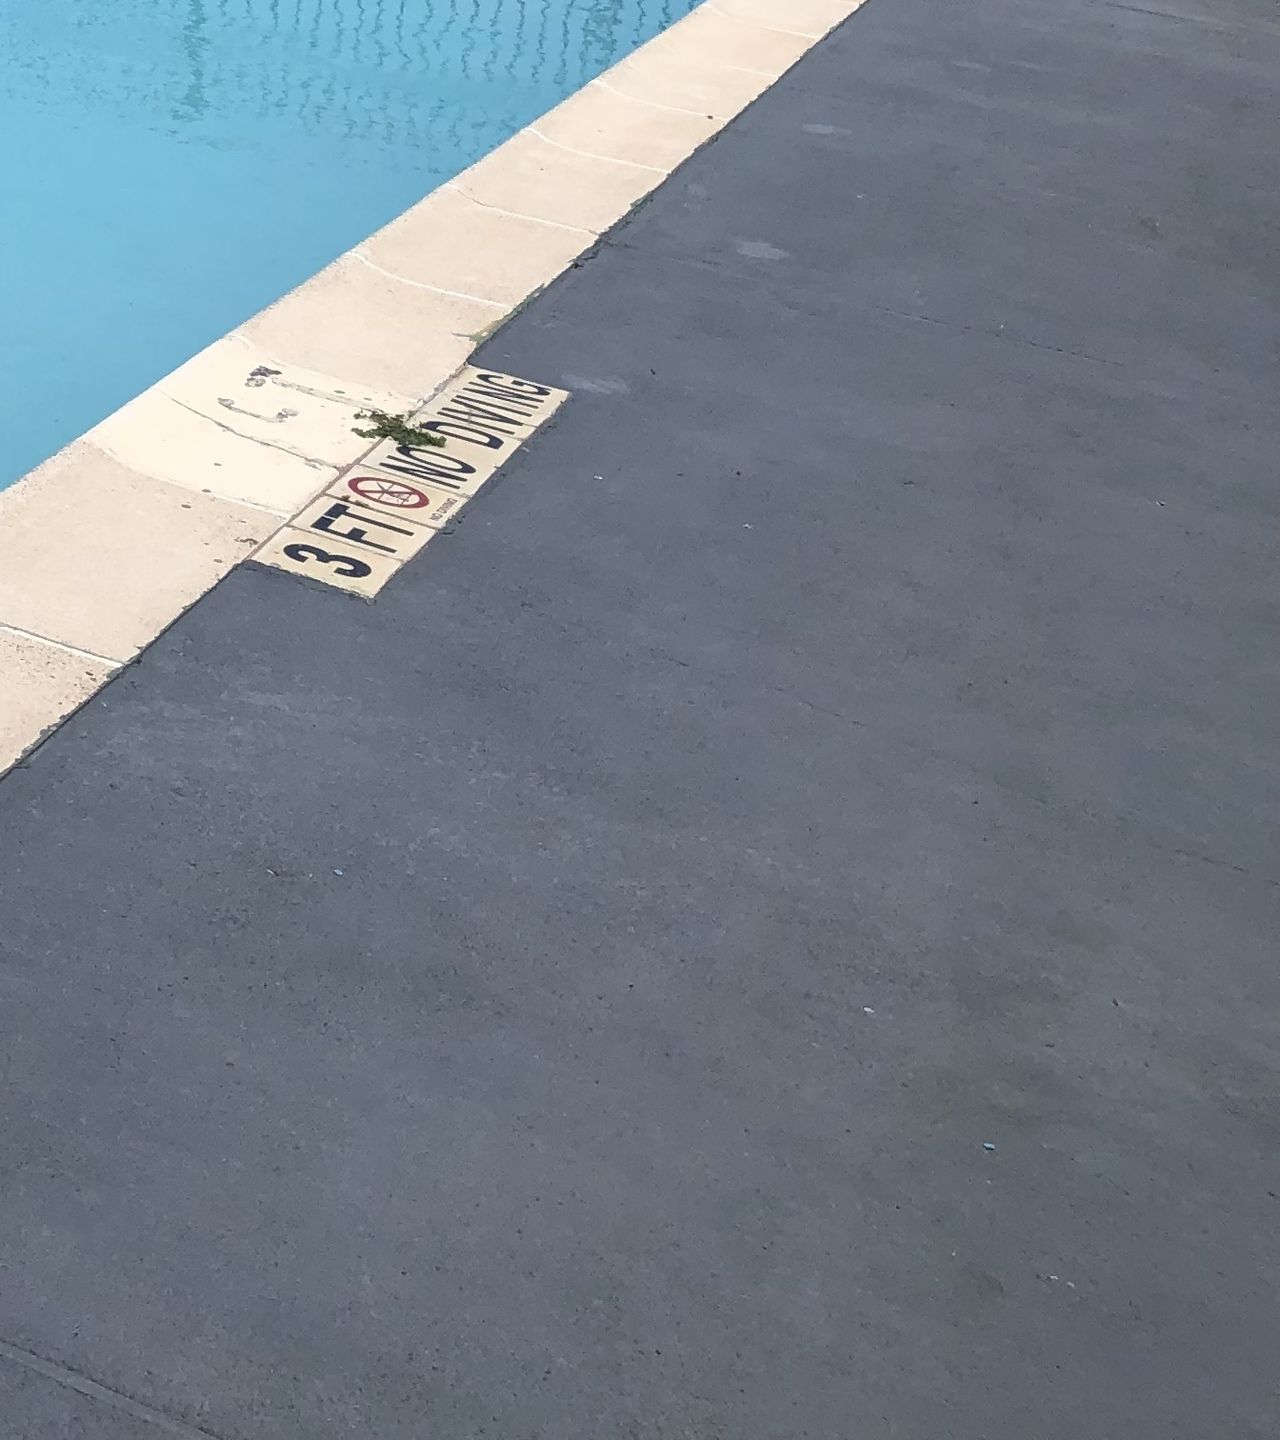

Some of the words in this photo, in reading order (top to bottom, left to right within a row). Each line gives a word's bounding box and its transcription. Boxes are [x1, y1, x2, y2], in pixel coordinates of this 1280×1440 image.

[420, 373, 552, 450] DIVING
[378, 445, 477, 490] NO
[310, 503, 415, 554] FT
[283, 543, 372, 578] 3
